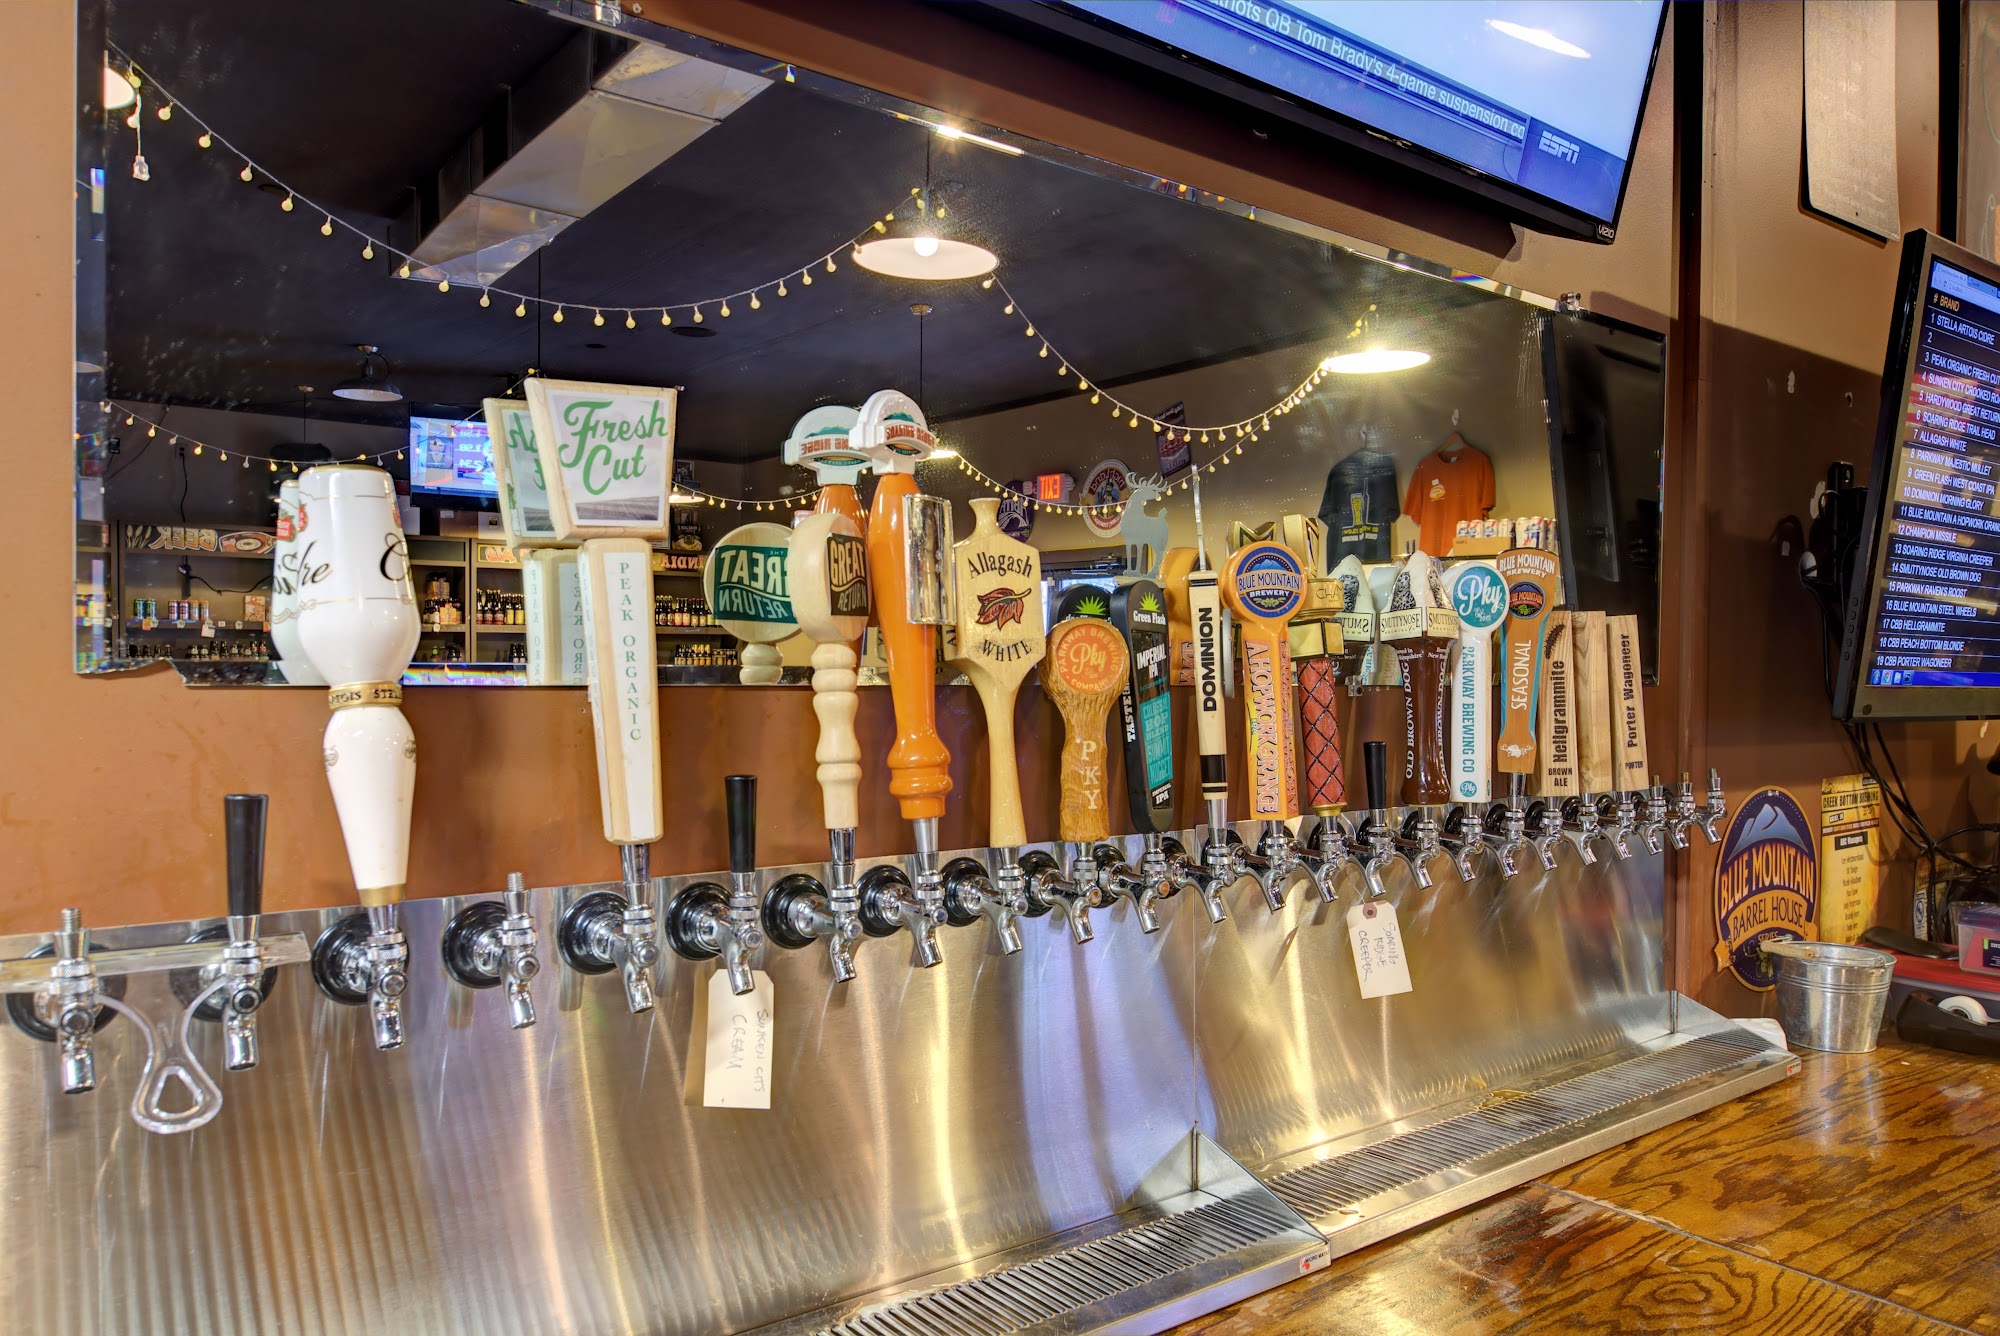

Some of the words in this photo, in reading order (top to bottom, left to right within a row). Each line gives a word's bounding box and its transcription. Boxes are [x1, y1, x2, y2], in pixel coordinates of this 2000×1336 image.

[1265, 8, 1292, 35] QB
[1296, 16, 1327, 51] Tom
[1330, 36, 1383, 75] Brady's
[1386, 64, 1436, 100] 4-game
[1438, 89, 1509, 133] suspension
[1539, 130, 1580, 165] ESPN
[1940, 295, 1960, 312] BRAND
[1937, 315, 1957, 332] STELLA
[1958, 323, 1978, 339] ARTOIS
[1978, 331, 1995, 345] CIDRE
[1931, 354, 1947, 368] PEAK
[1947, 359, 1972, 375] ORGANIC
[1972, 367, 1990, 382] FRESH
[1928, 373, 1952, 389] SUNKEN
[1952, 380, 1965, 392] CITY
[1965, 385, 1990, 401] CROOKED
[1925, 392, 1962, 412] HARDYWOOD
[1962, 403, 1981, 416] GREAT
[558, 400, 668, 468] Fresh
[1923, 412, 1948, 427] SOARING
[1949, 418, 1966, 432] RIDGE
[1967, 423, 1980, 437] TRAIL
[1980, 427, 1996, 440] HEAD
[1919, 431, 1949, 447] ALLAGASH
[1949, 438, 1967, 451] WHITE
[583, 444, 646, 495] Cut
[1917, 450, 1945, 465] PARKWAY
[1945, 456, 1971, 471] MAJESTIC
[1971, 464, 1992, 476] MULLET
[1914, 469, 1934, 482] GREEN
[1935, 473, 1952, 486] FLASH
[1952, 476, 1968, 489] WEST
[1968, 481, 1986, 493] COAST
[1986, 484, 1995, 495] IPA
[1911, 488, 1940, 502] DOMINION
[1940, 494, 1965, 508] MORNING
[1965, 500, 1985, 511] GLORY
[1908, 506, 1924, 518] BLUE
[1924, 510, 1952, 524] MOUNTAIN
[1957, 516, 1984, 529] HOPWORK
[1905, 525, 1935, 540] CHAMPION
[1935, 530, 1957, 543] MISSILE
[830, 539, 865, 586] GREAT
[967, 551, 1032, 579] Allagash
[1500, 555, 1516, 573] BLUE
[1517, 554, 1555, 574] MOUNTAIN
[1902, 544, 1928, 557] SOARING
[1928, 549, 1946, 560] RIDGE
[1946, 551, 1968, 563] VIRGINIA
[1969, 555, 1993, 566] CREEPER
[1239, 573, 1256, 591] BLUE
[1258, 572, 1300, 590] MOUNTAIN
[1507, 568, 1547, 578] BREWERY
[1899, 563, 1938, 577] SMUTTYNOSE
[1937, 568, 1949, 579] OLD
[1949, 569, 1969, 581] BROWN
[1969, 572, 1981, 582] DOG
[619, 562, 633, 622] PEAK
[838, 584, 867, 612] RETURN
[1250, 589, 1290, 598] BREWERY
[1458, 574, 1502, 617] Pky
[1896, 582, 1925, 594] PARKWAY
[1948, 588, 1967, 598] ROOST
[1133, 610, 1151, 623] Green
[1152, 613, 1166, 625] Flash
[1893, 600, 1909, 611] BLUE
[1909, 602, 1938, 614] MOUNTAIN
[1938, 605, 1955, 615] STEEL
[1956, 606, 1977, 617] WHEELS
[1381, 613, 1420, 633] SMUTTYNOSE
[1890, 619, 1903, 630] CBB
[982, 639, 1032, 662] WHITE
[1059, 628, 1087, 673] PARKWAY
[1090, 628, 1119, 671] BREWING
[1137, 643, 1167, 670] IMPERIAL
[1245, 641, 1268, 660] A
[1887, 638, 1899, 648] CBB
[1900, 638, 1920, 649] PEACH
[1920, 639, 1942, 650] BOTTOM
[1943, 641, 1965, 651] BLONDE
[1070, 643, 1106, 675] Pky
[1149, 662, 1158, 678] IPA
[1199, 607, 1217, 711] DOMINION
[1462, 646, 1475, 699] PARKWAY
[1620, 634, 1634, 700] Wagoneer
[1884, 656, 1897, 666] CBB
[1897, 656, 1921, 667] PORTER
[1921, 657, 1952, 668] WAGONEER
[622, 634, 641, 742] ORGANIC
[1401, 662, 1411, 693] DOG
[1511, 640, 1532, 710] SEASONAL
[1250, 658, 1278, 746] HOPWORK
[1123, 695, 1136, 742] TASTE
[1145, 712, 1168, 731] HOP
[1146, 724, 1168, 740] BLEND
[1406, 697, 1414, 747] BROWN
[1462, 703, 1475, 755] BREWING
[1626, 706, 1638, 748] Porter
[1080, 741, 1100, 810] PKY
[1406, 750, 1414, 779] OLD
[1462, 759, 1475, 773] CO
[1548, 767, 1573, 776] BROWN
[1625, 760, 1643, 770] PORTER
[1256, 745, 1280, 813] ORANGE
[1554, 778, 1568, 786] ALE
[1156, 791, 1169, 804] IPA
[1720, 861, 1749, 920] BLUE
[1752, 843, 1814, 904] MOUNTAIN
[1733, 904, 1769, 942] BARREL
[1771, 896, 1804, 930] HOUSE
